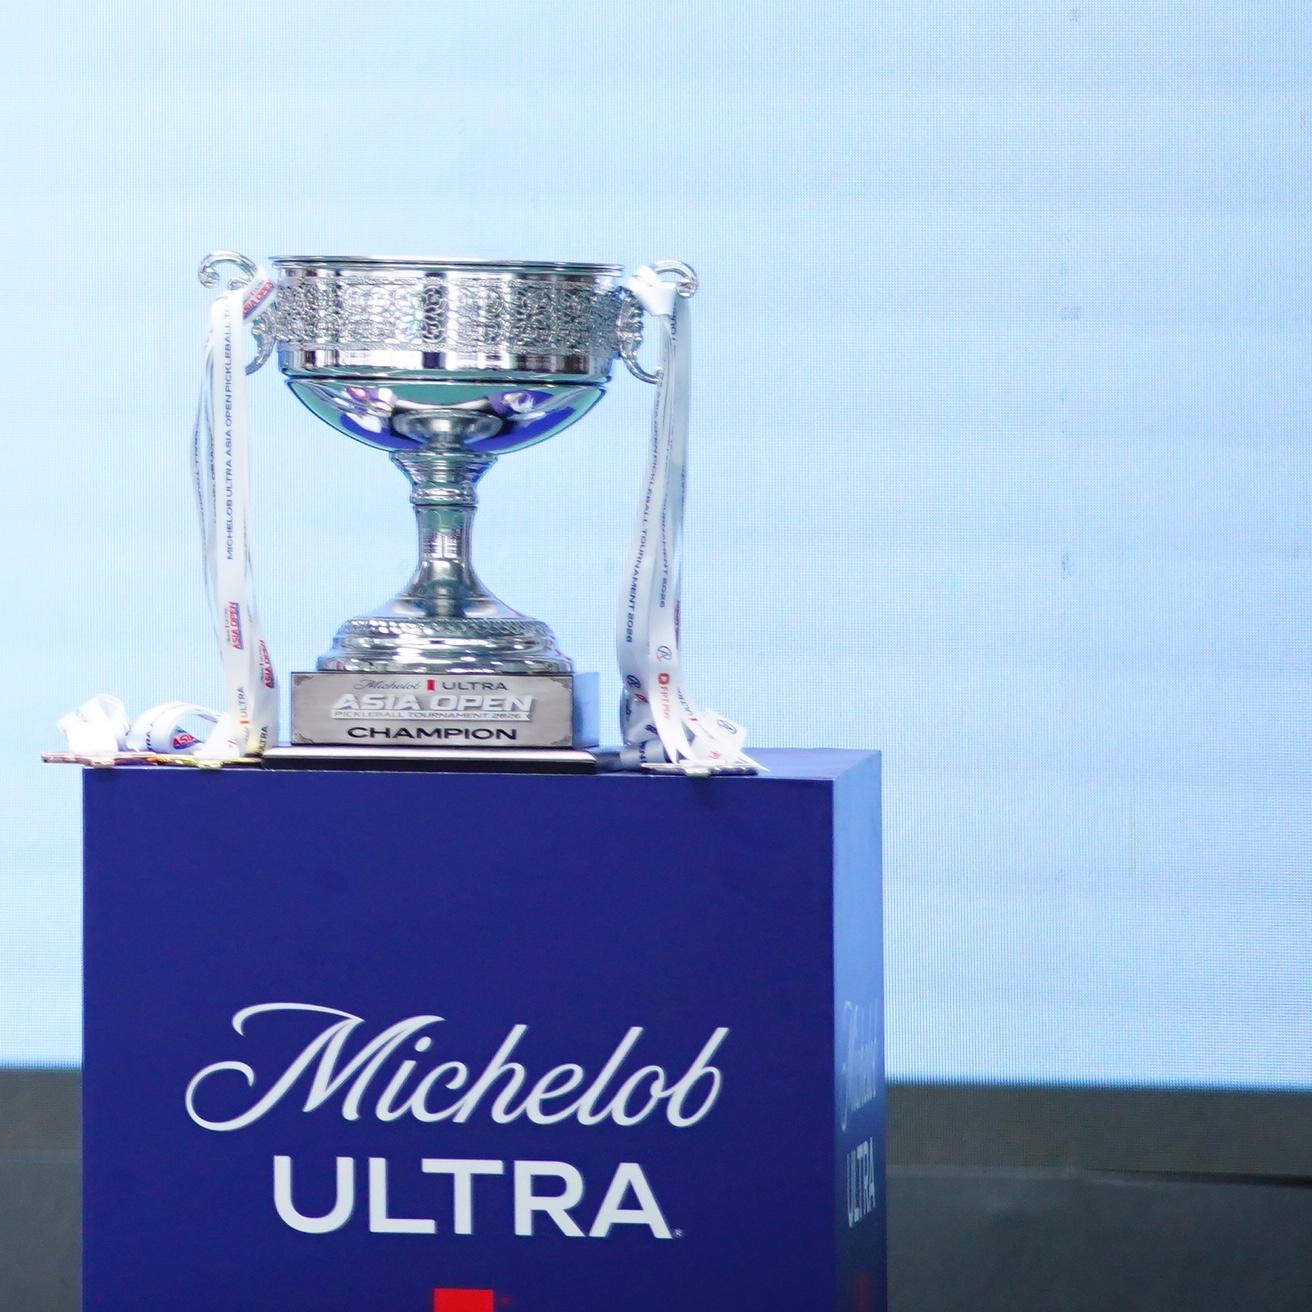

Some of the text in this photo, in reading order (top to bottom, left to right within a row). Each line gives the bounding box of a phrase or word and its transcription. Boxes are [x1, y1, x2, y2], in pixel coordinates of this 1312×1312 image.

[224, 394, 233, 427] OPEN
[224, 429, 233, 456] ASIA
[224, 458, 233, 497] ULTRA
[442, 681, 509, 692] ULTRA
[332, 692, 535, 712] ASIA OPEN
[334, 711, 403, 719] PICKLEBALL
[408, 711, 489, 720] TOURNAMENT
[347, 726, 519, 741] CHAMPION
[184, 1000, 729, 1132] Michelob
